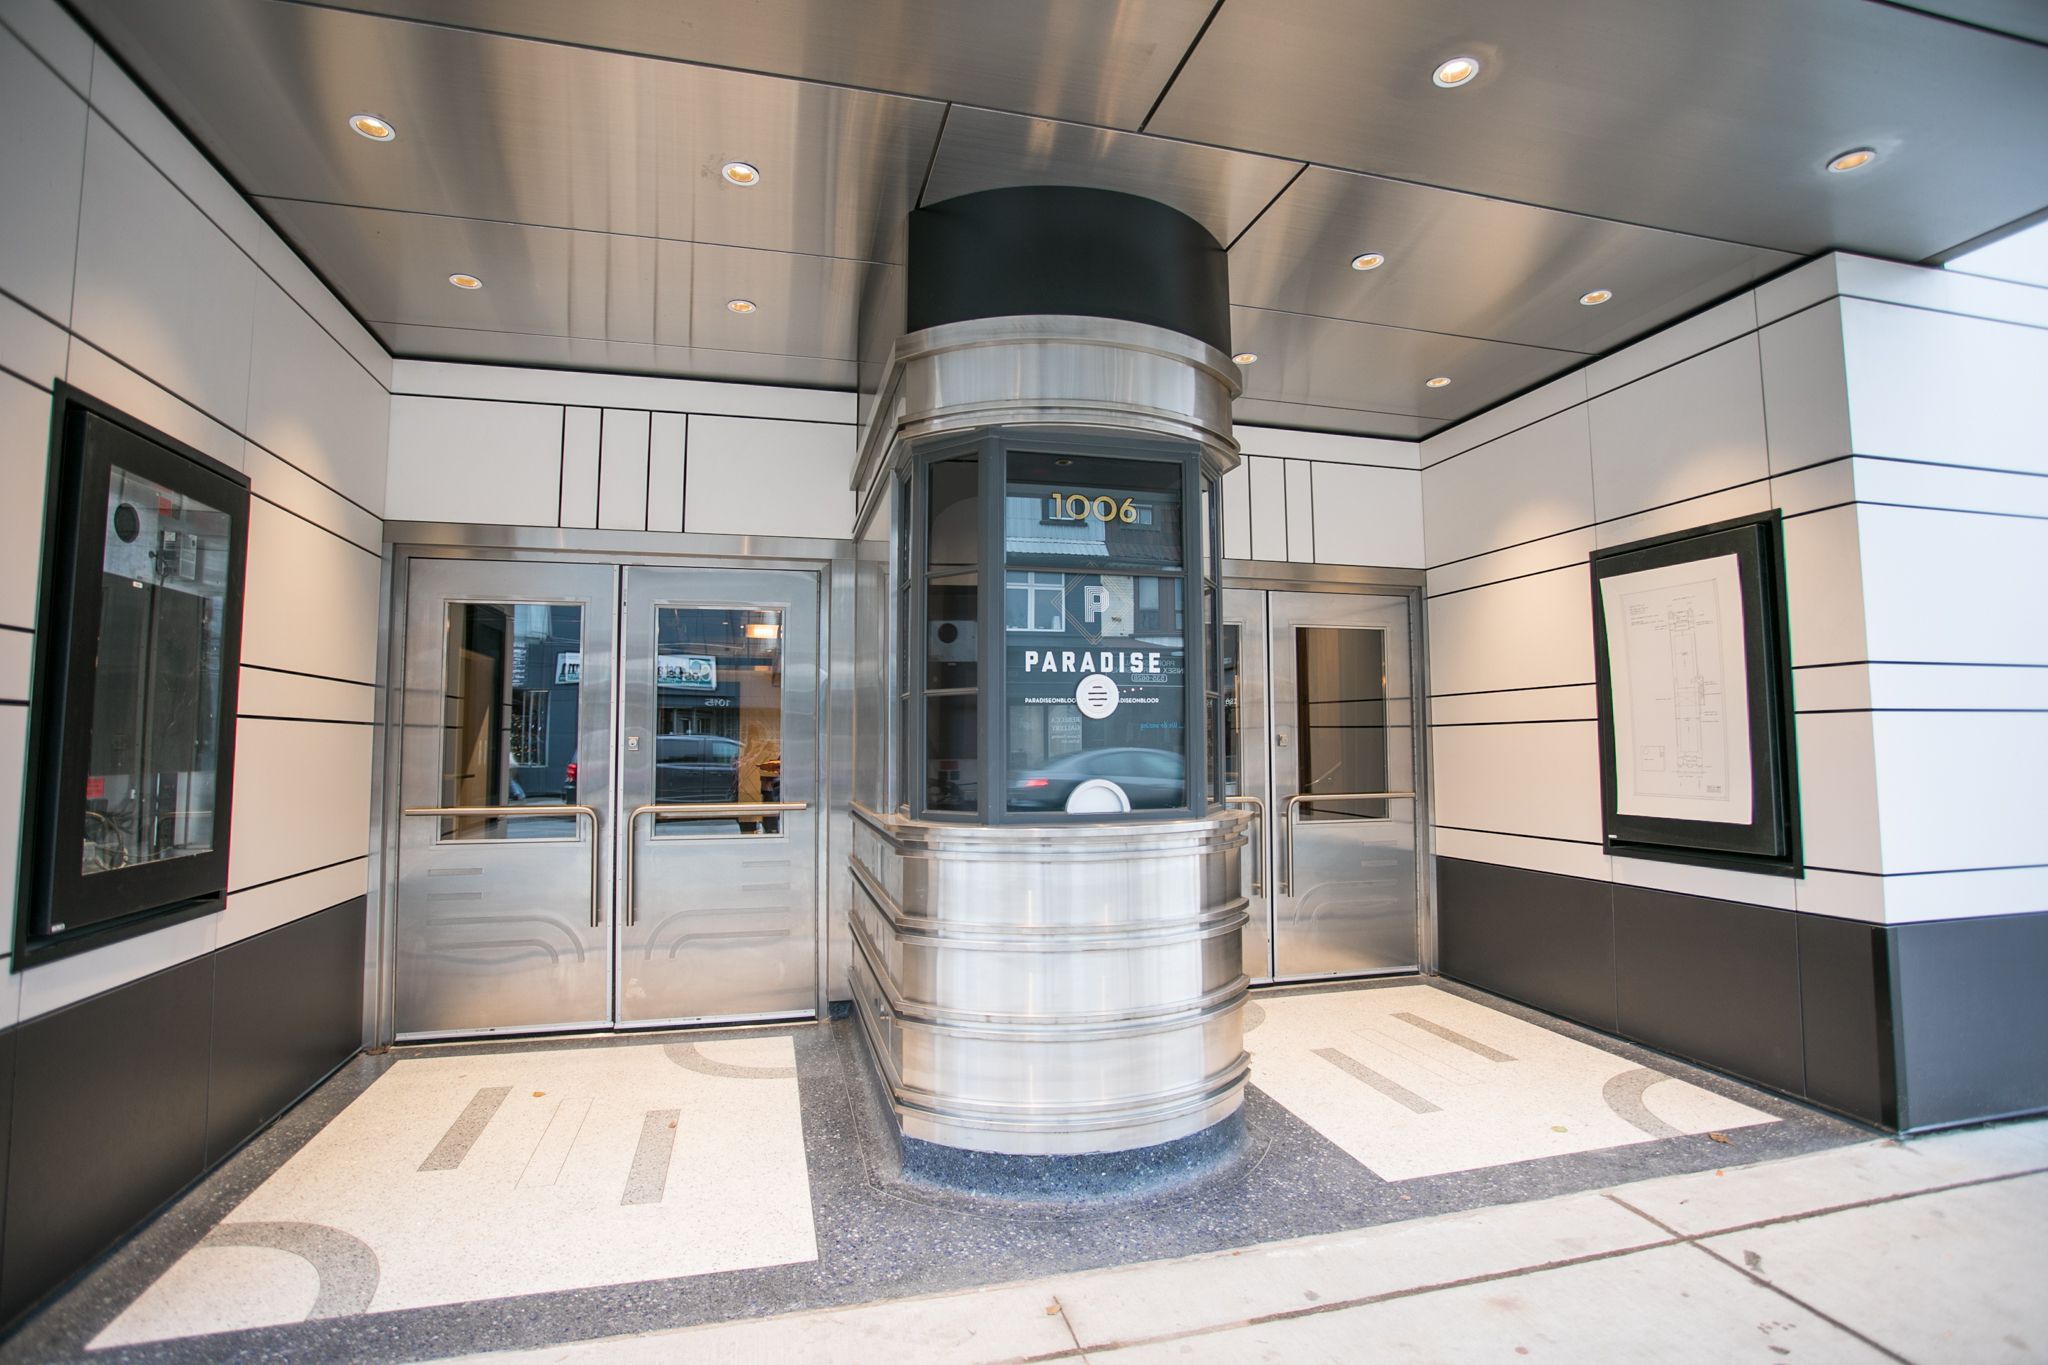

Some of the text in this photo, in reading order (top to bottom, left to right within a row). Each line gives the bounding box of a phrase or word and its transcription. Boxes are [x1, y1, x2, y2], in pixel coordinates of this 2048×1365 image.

[1051, 492, 1137, 524] 1006
[1084, 585, 1110, 623] P
[1024, 651, 1161, 673] PARADISE
